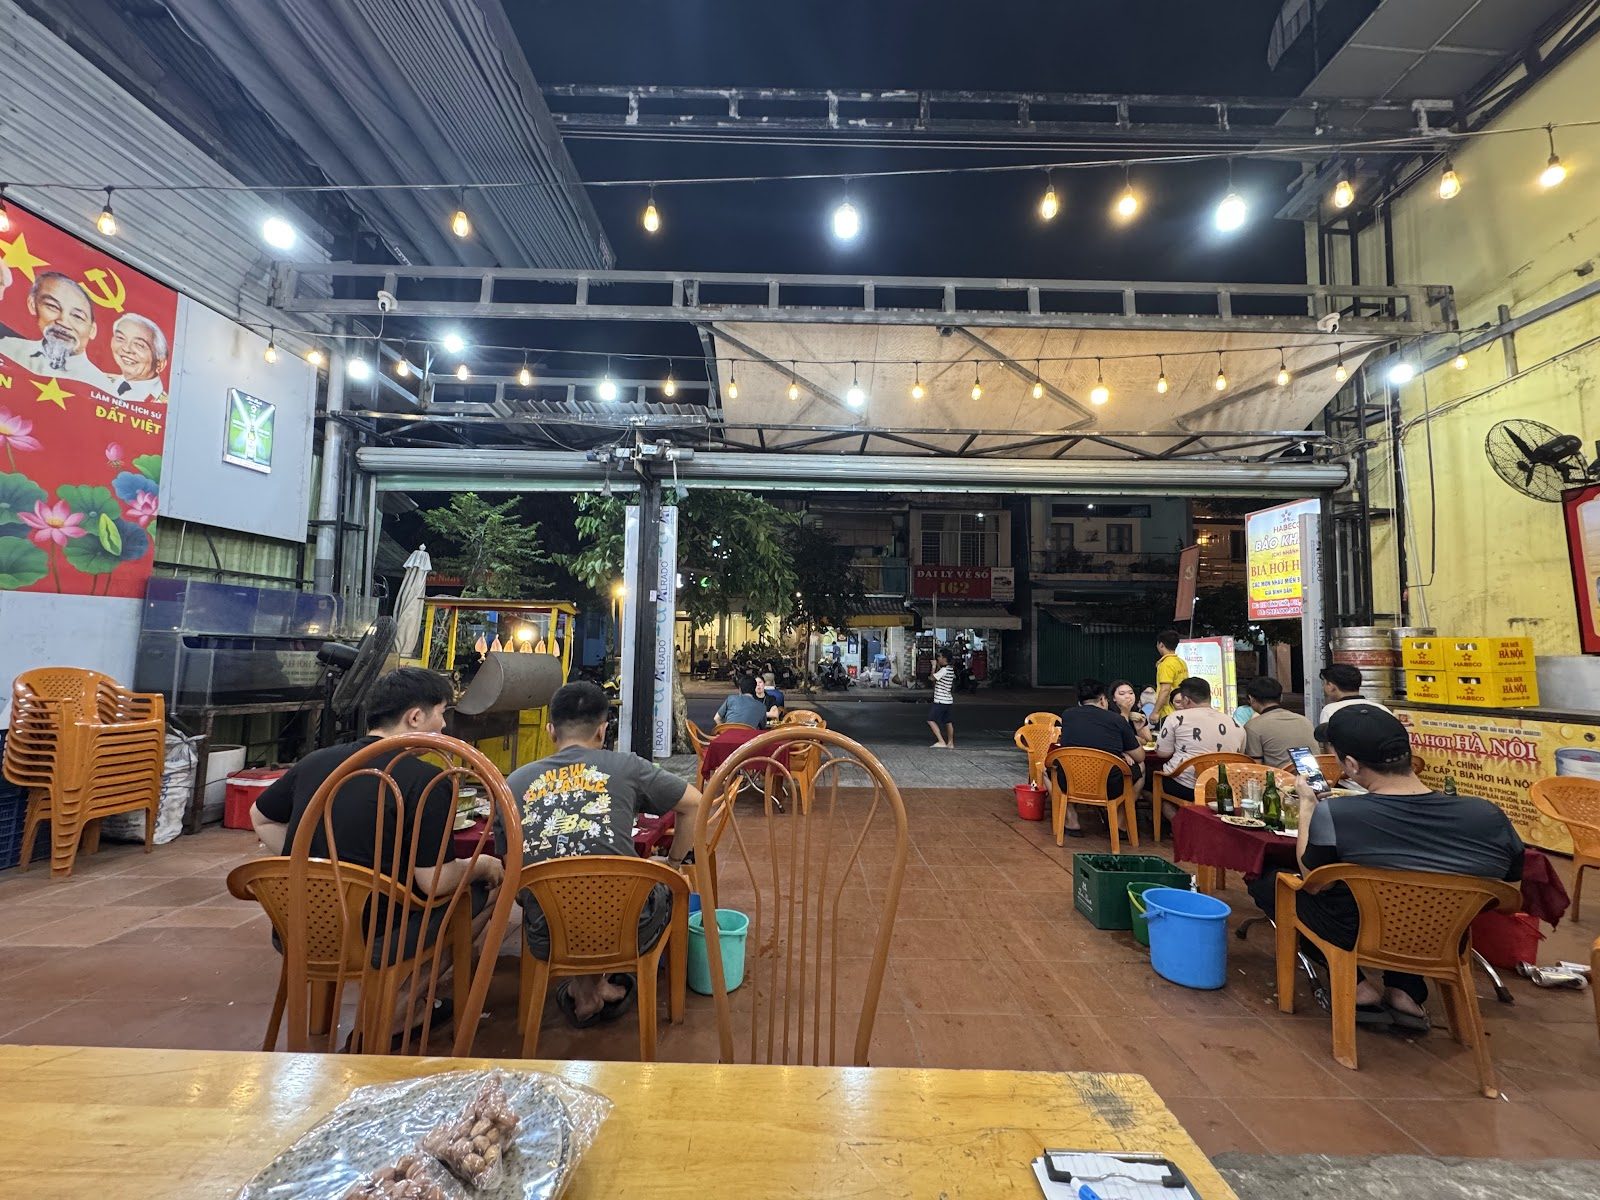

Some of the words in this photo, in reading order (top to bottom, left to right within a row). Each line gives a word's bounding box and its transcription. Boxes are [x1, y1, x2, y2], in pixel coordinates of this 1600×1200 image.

[130, 416, 162, 434] VIỆT
[1281, 533, 1300, 547] KH
[1251, 565, 1267, 576] BIA
[1270, 560, 1288, 574] HƠI
[940, 582, 970, 594] 162
[1193, 728, 1202, 742] R
[1408, 732, 1423, 746] IA
[1453, 732, 1488, 754] HÀ
[545, 764, 586, 782] NEW
[1456, 760, 1483, 772] CHÍNH
[1460, 771, 1475, 780] BIA
[1477, 774, 1495, 784] HƠI
[1497, 776, 1512, 786] HÀ
[1514, 779, 1532, 790] NỘ
